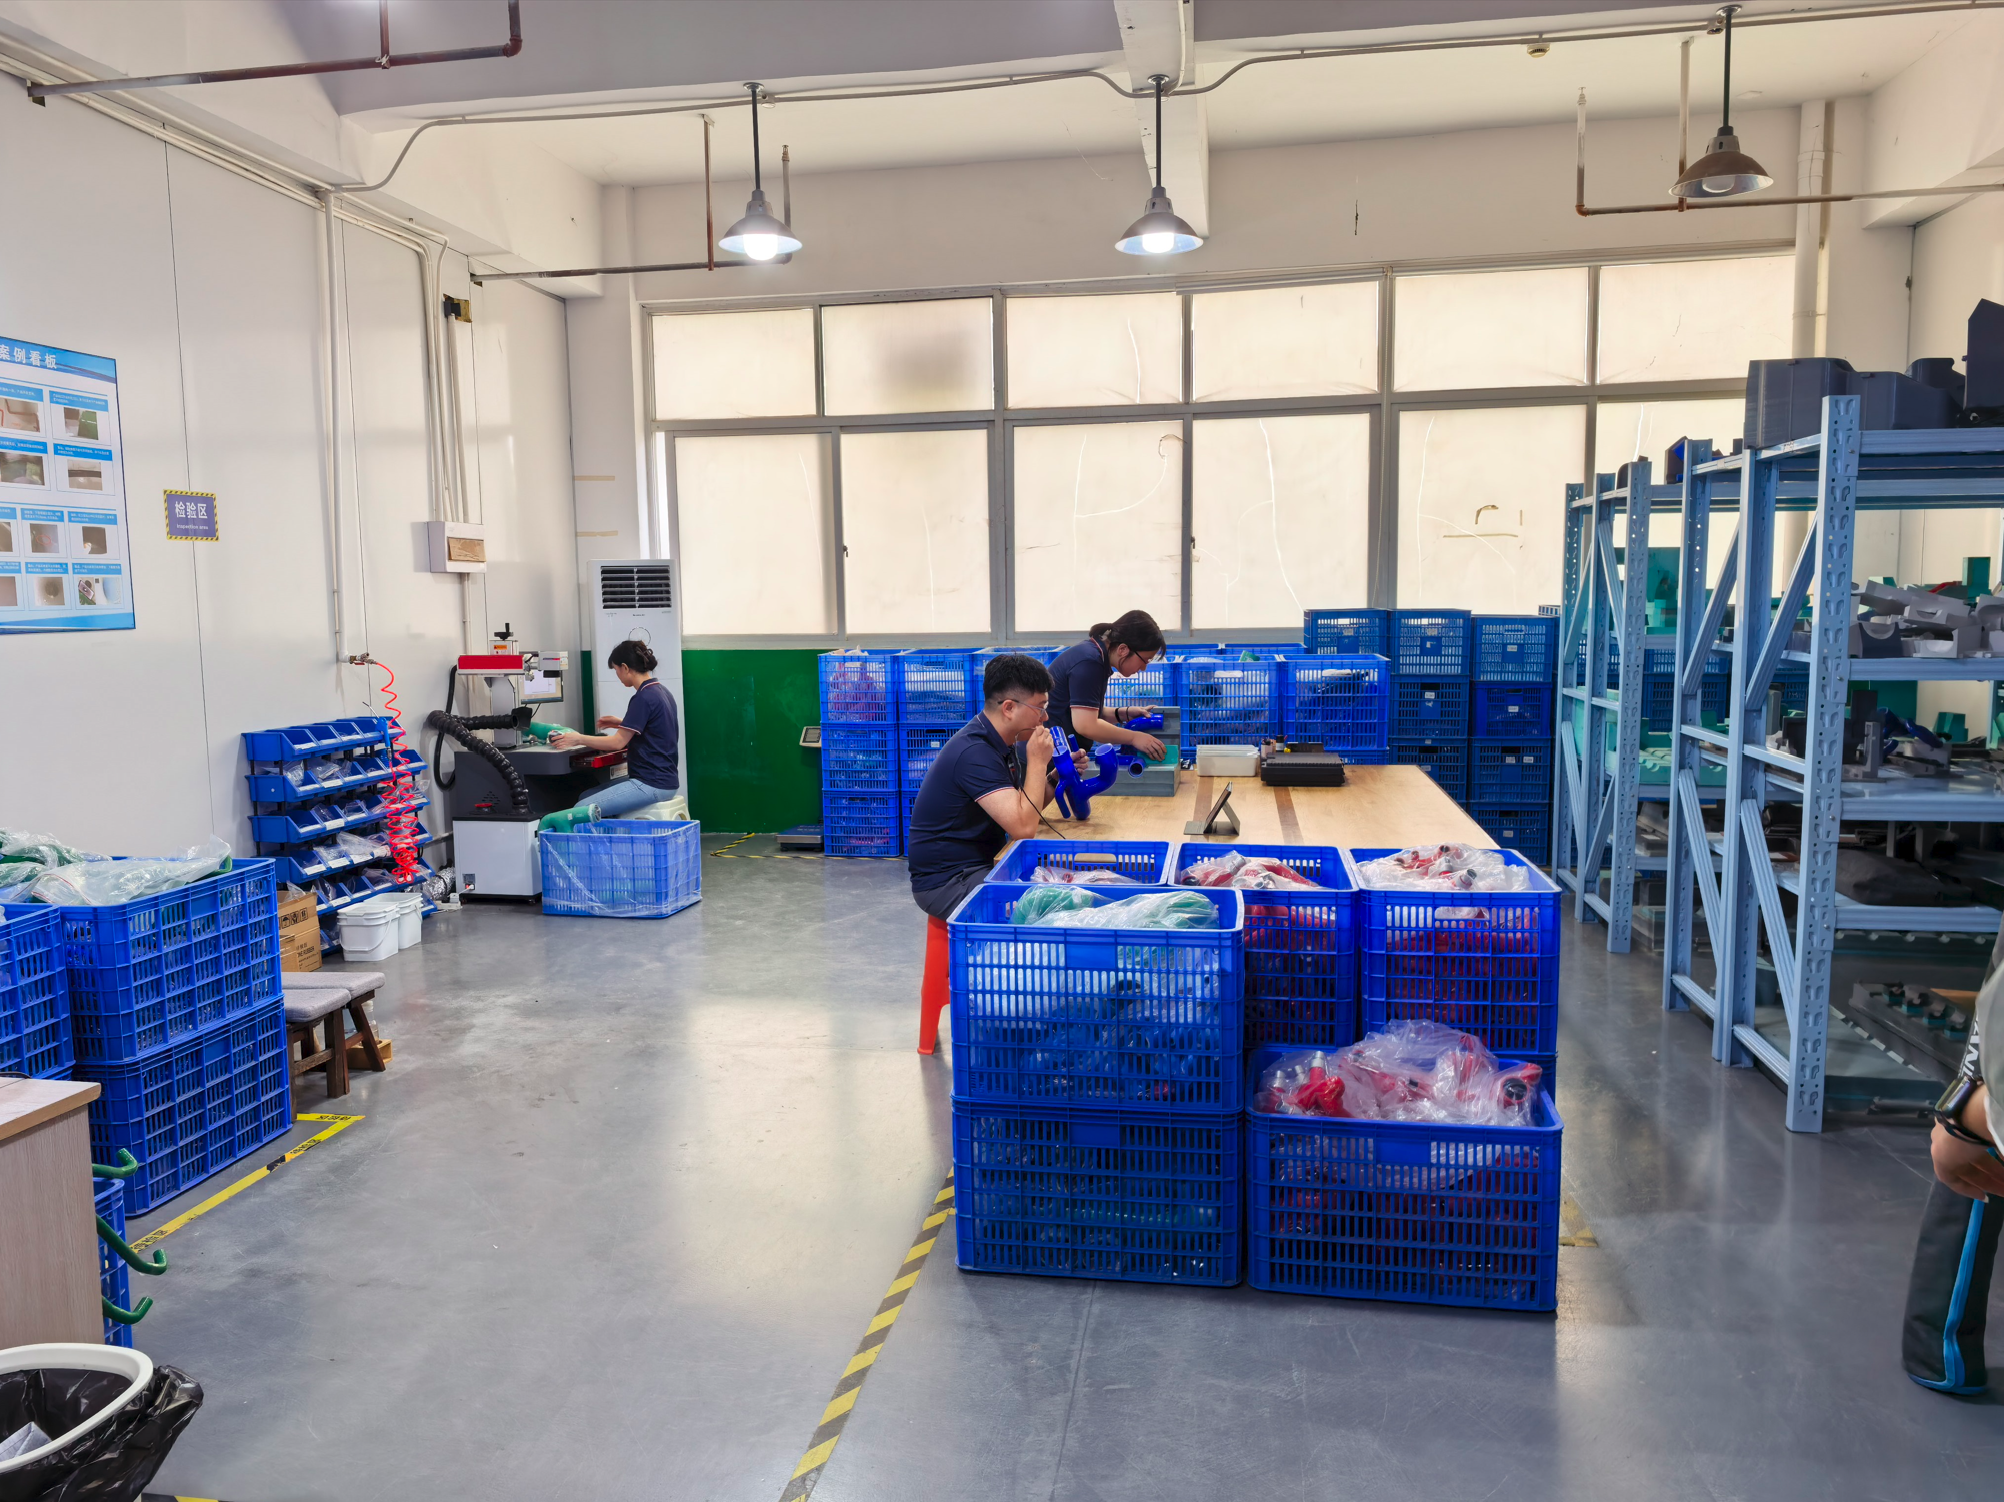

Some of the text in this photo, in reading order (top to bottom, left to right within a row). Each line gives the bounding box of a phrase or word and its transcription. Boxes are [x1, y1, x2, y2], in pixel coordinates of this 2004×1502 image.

[0, 344, 57, 369] 案例看板
[175, 501, 208, 519] 检验区
